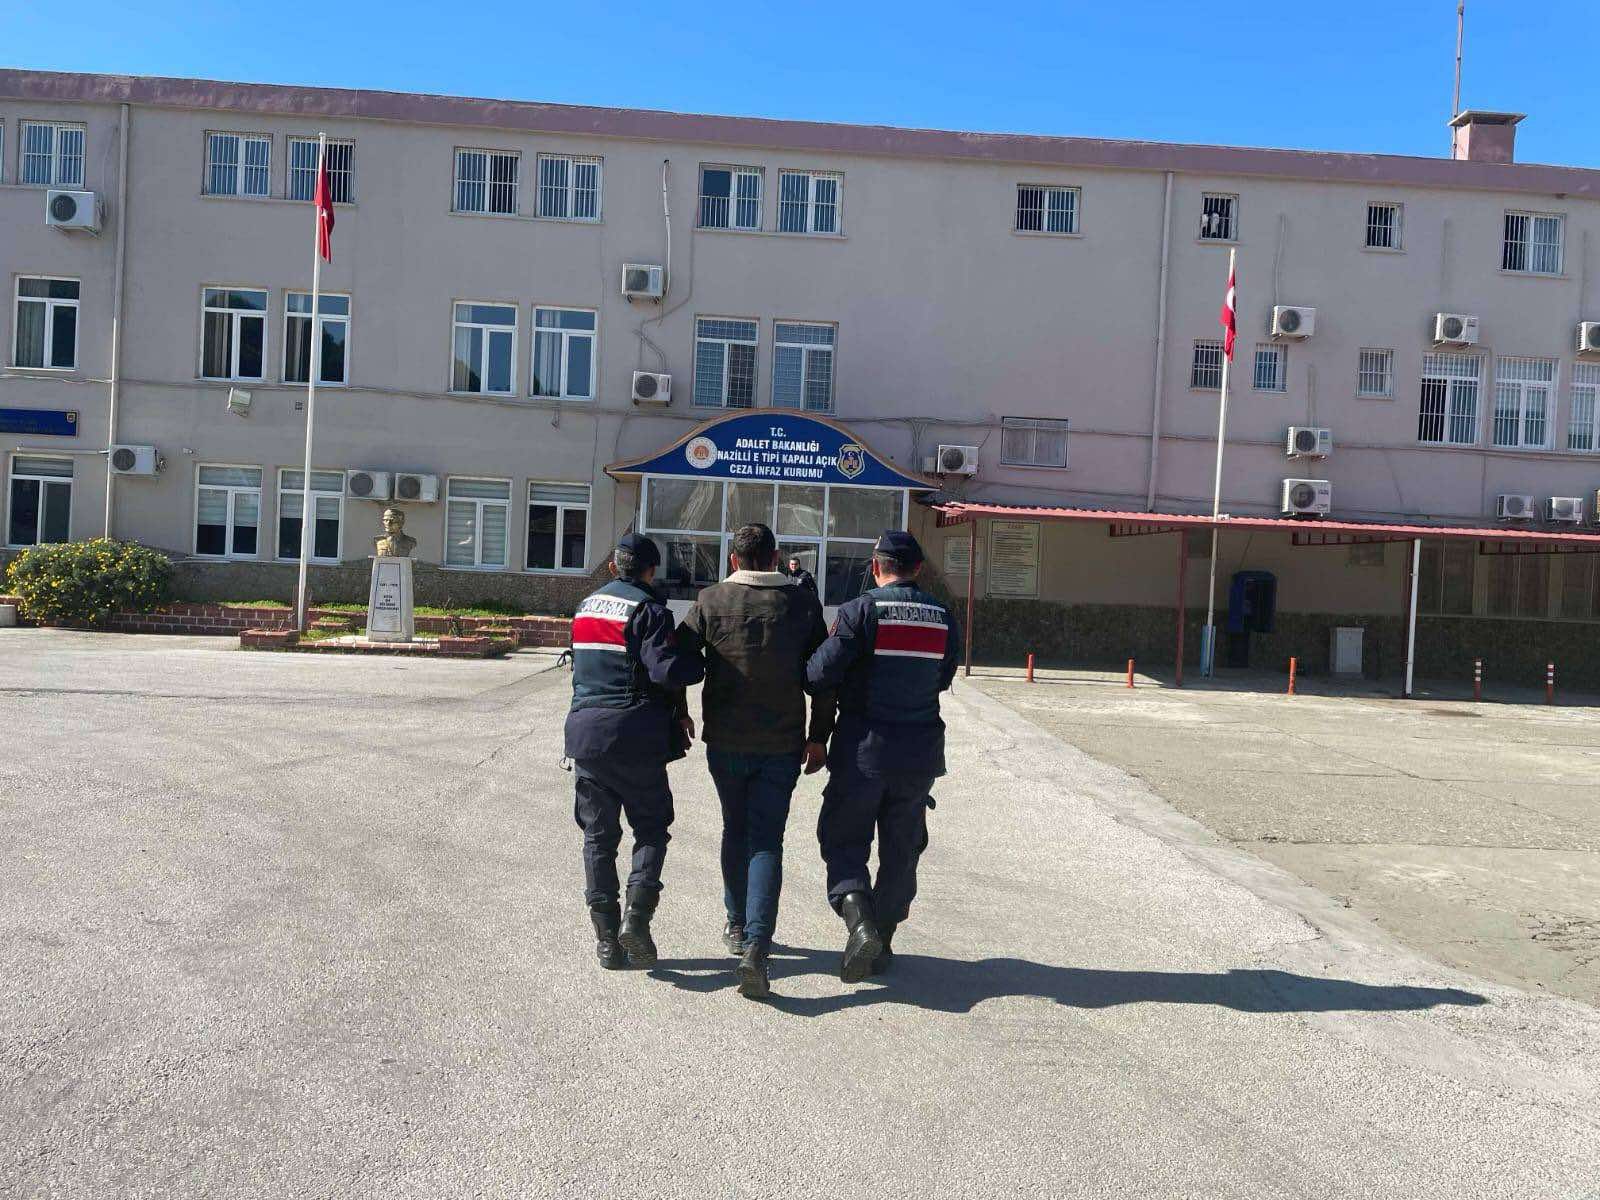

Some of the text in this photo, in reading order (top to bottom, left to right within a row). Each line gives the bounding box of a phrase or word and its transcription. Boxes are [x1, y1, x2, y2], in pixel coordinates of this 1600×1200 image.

[770, 427, 786, 437] T.C.
[736, 438, 819, 452] ADALET BAKANLIĞI
[717, 449, 838, 467] NAZİLLİ E TİPİ KAPALI AÇIK
[729, 464, 823, 478] CEZA İNFAZ KURUMU
[884, 606, 943, 623] JANDARMA
